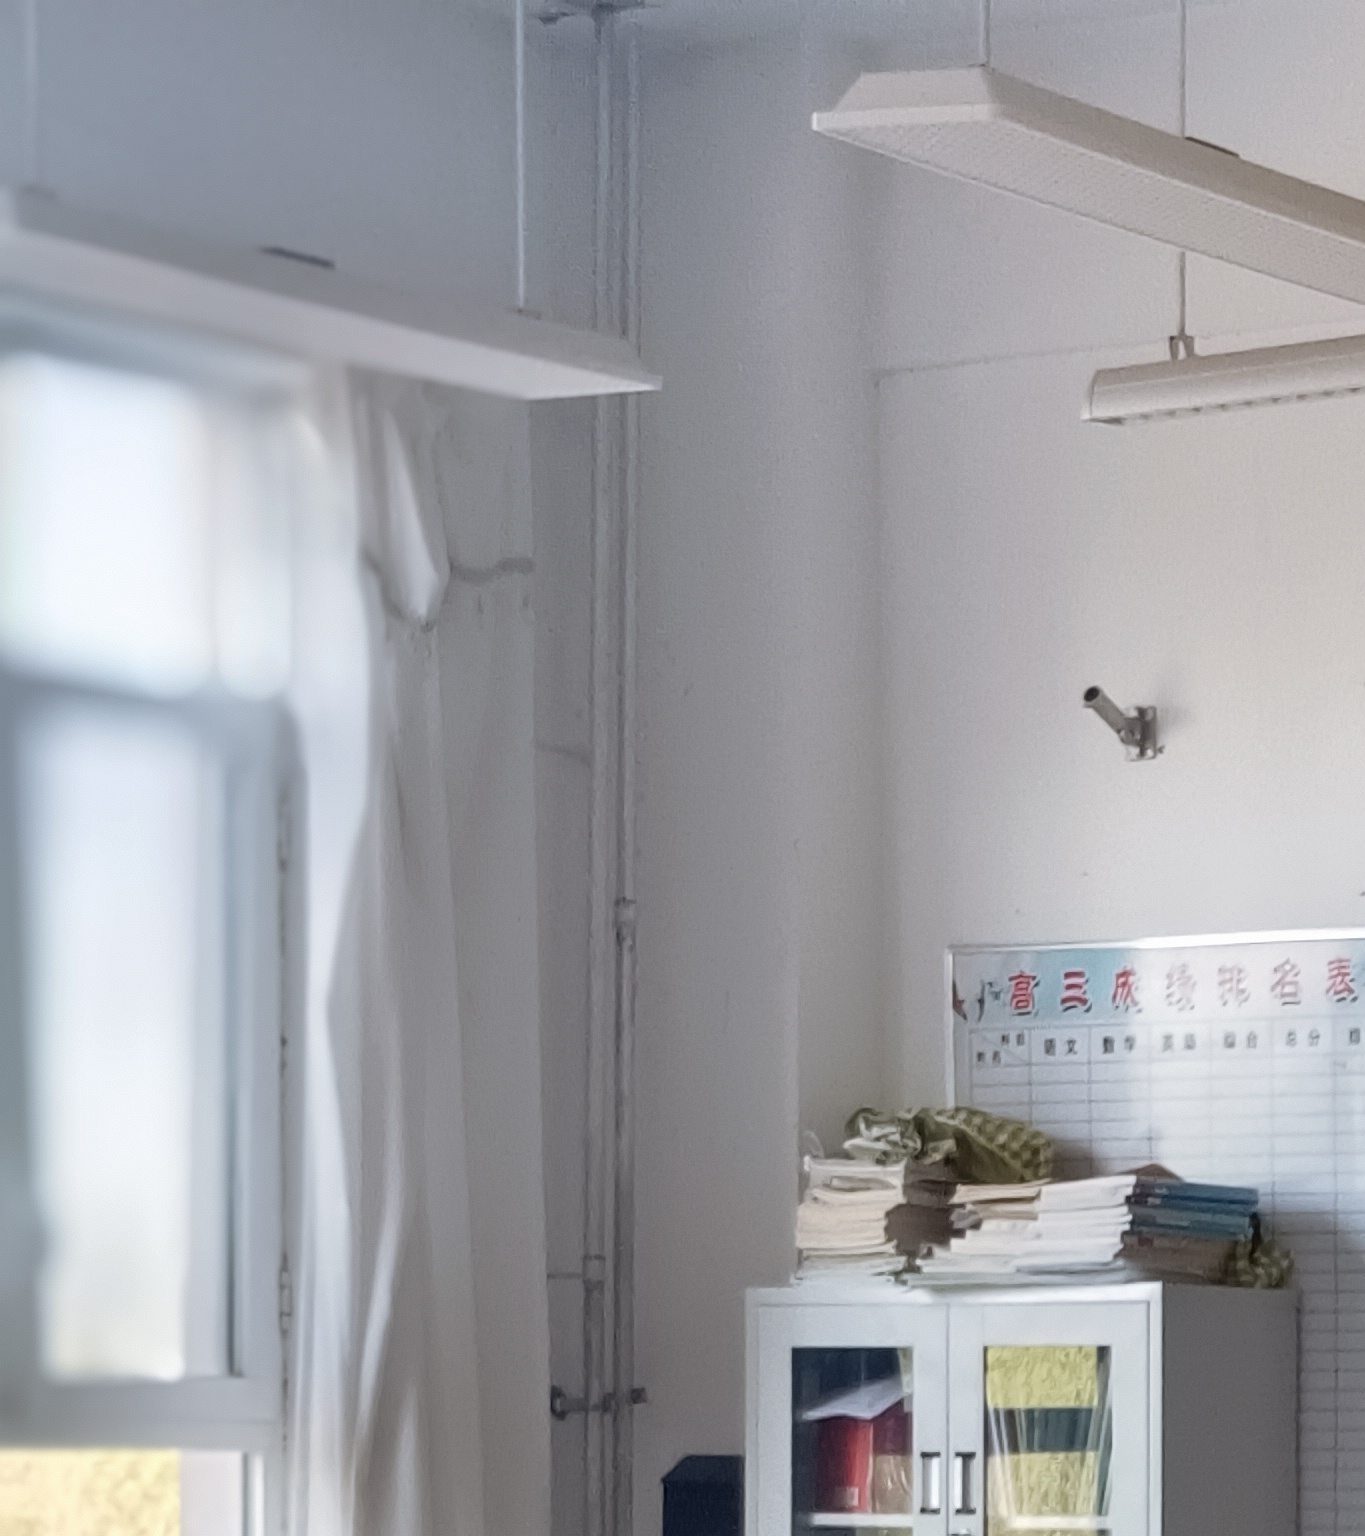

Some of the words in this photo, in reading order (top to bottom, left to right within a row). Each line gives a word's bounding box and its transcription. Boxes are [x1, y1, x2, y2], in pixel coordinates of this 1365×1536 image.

[1008, 957, 1358, 1015] 高三成绩排名表
